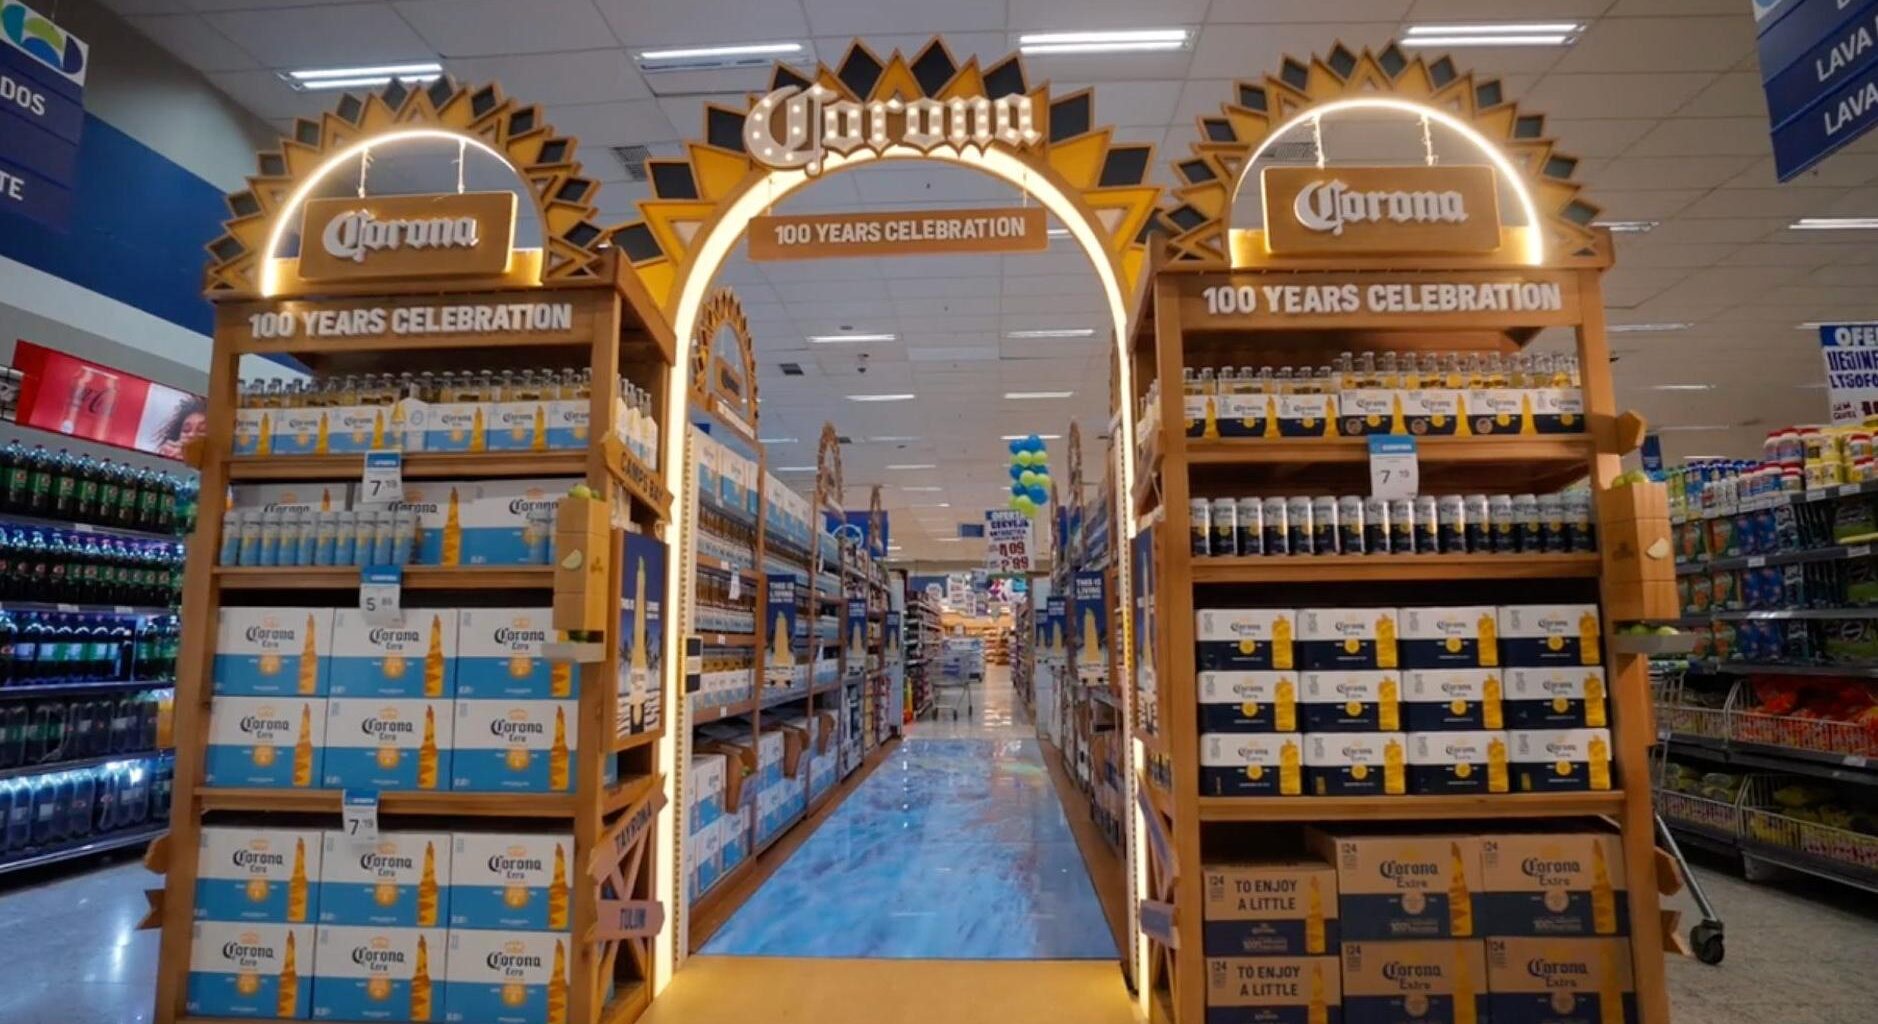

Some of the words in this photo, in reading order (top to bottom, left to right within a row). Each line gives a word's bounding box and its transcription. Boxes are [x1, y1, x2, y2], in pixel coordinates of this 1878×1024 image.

[1816, 27, 1873, 82] LAVA
[1824, 82, 1878, 136] LAVA
[743, 82, 1042, 177] Corona
[1293, 179, 1469, 236] Corona
[322, 208, 480, 262] Corona
[774, 222, 812, 246] 100
[815, 219, 882, 243] YEARS
[884, 216, 1026, 242] CELEBRATION
[1202, 287, 1257, 315] 100
[1262, 284, 1359, 314] YEARS
[1367, 281, 1562, 312] CELEBRATION
[249, 311, 293, 339] 100
[302, 306, 385, 336] YEARS
[390, 302, 573, 335] CELEBRATION
[1834, 326, 1878, 348] OFE
[1381, 470, 1390, 484] 7
[370, 480, 381, 496] 7
[366, 597, 376, 611] 5
[246, 626, 294, 642] Corona
[369, 628, 419, 644] Corona
[494, 627, 544, 643] Corona
[240, 716, 289, 733] Corona
[362, 718, 413, 734] Corona
[490, 719, 543, 735] Corona
[349, 819, 359, 836] 7
[233, 849, 283, 867] Corona
[360, 853, 412, 870] Corona
[488, 855, 541, 872] Corona
[1380, 860, 1439, 878] Corona
[1521, 857, 1581, 877] Corona
[1235, 880, 1252, 893] TO
[1255, 879, 1297, 893] ENJOY
[1238, 898, 1247, 911] A
[1250, 897, 1296, 911] LITTLE
[223, 941, 274, 959] Corona
[352, 947, 404, 964] Corona
[486, 951, 541, 970] Corona
[1527, 958, 1587, 977] Corona
[1237, 966, 1254, 980] TO
[1257, 966, 1300, 979] ENJOY
[1382, 960, 1441, 980] Corona
[1240, 985, 1249, 997] A
[1252, 984, 1298, 996] LITTLE
